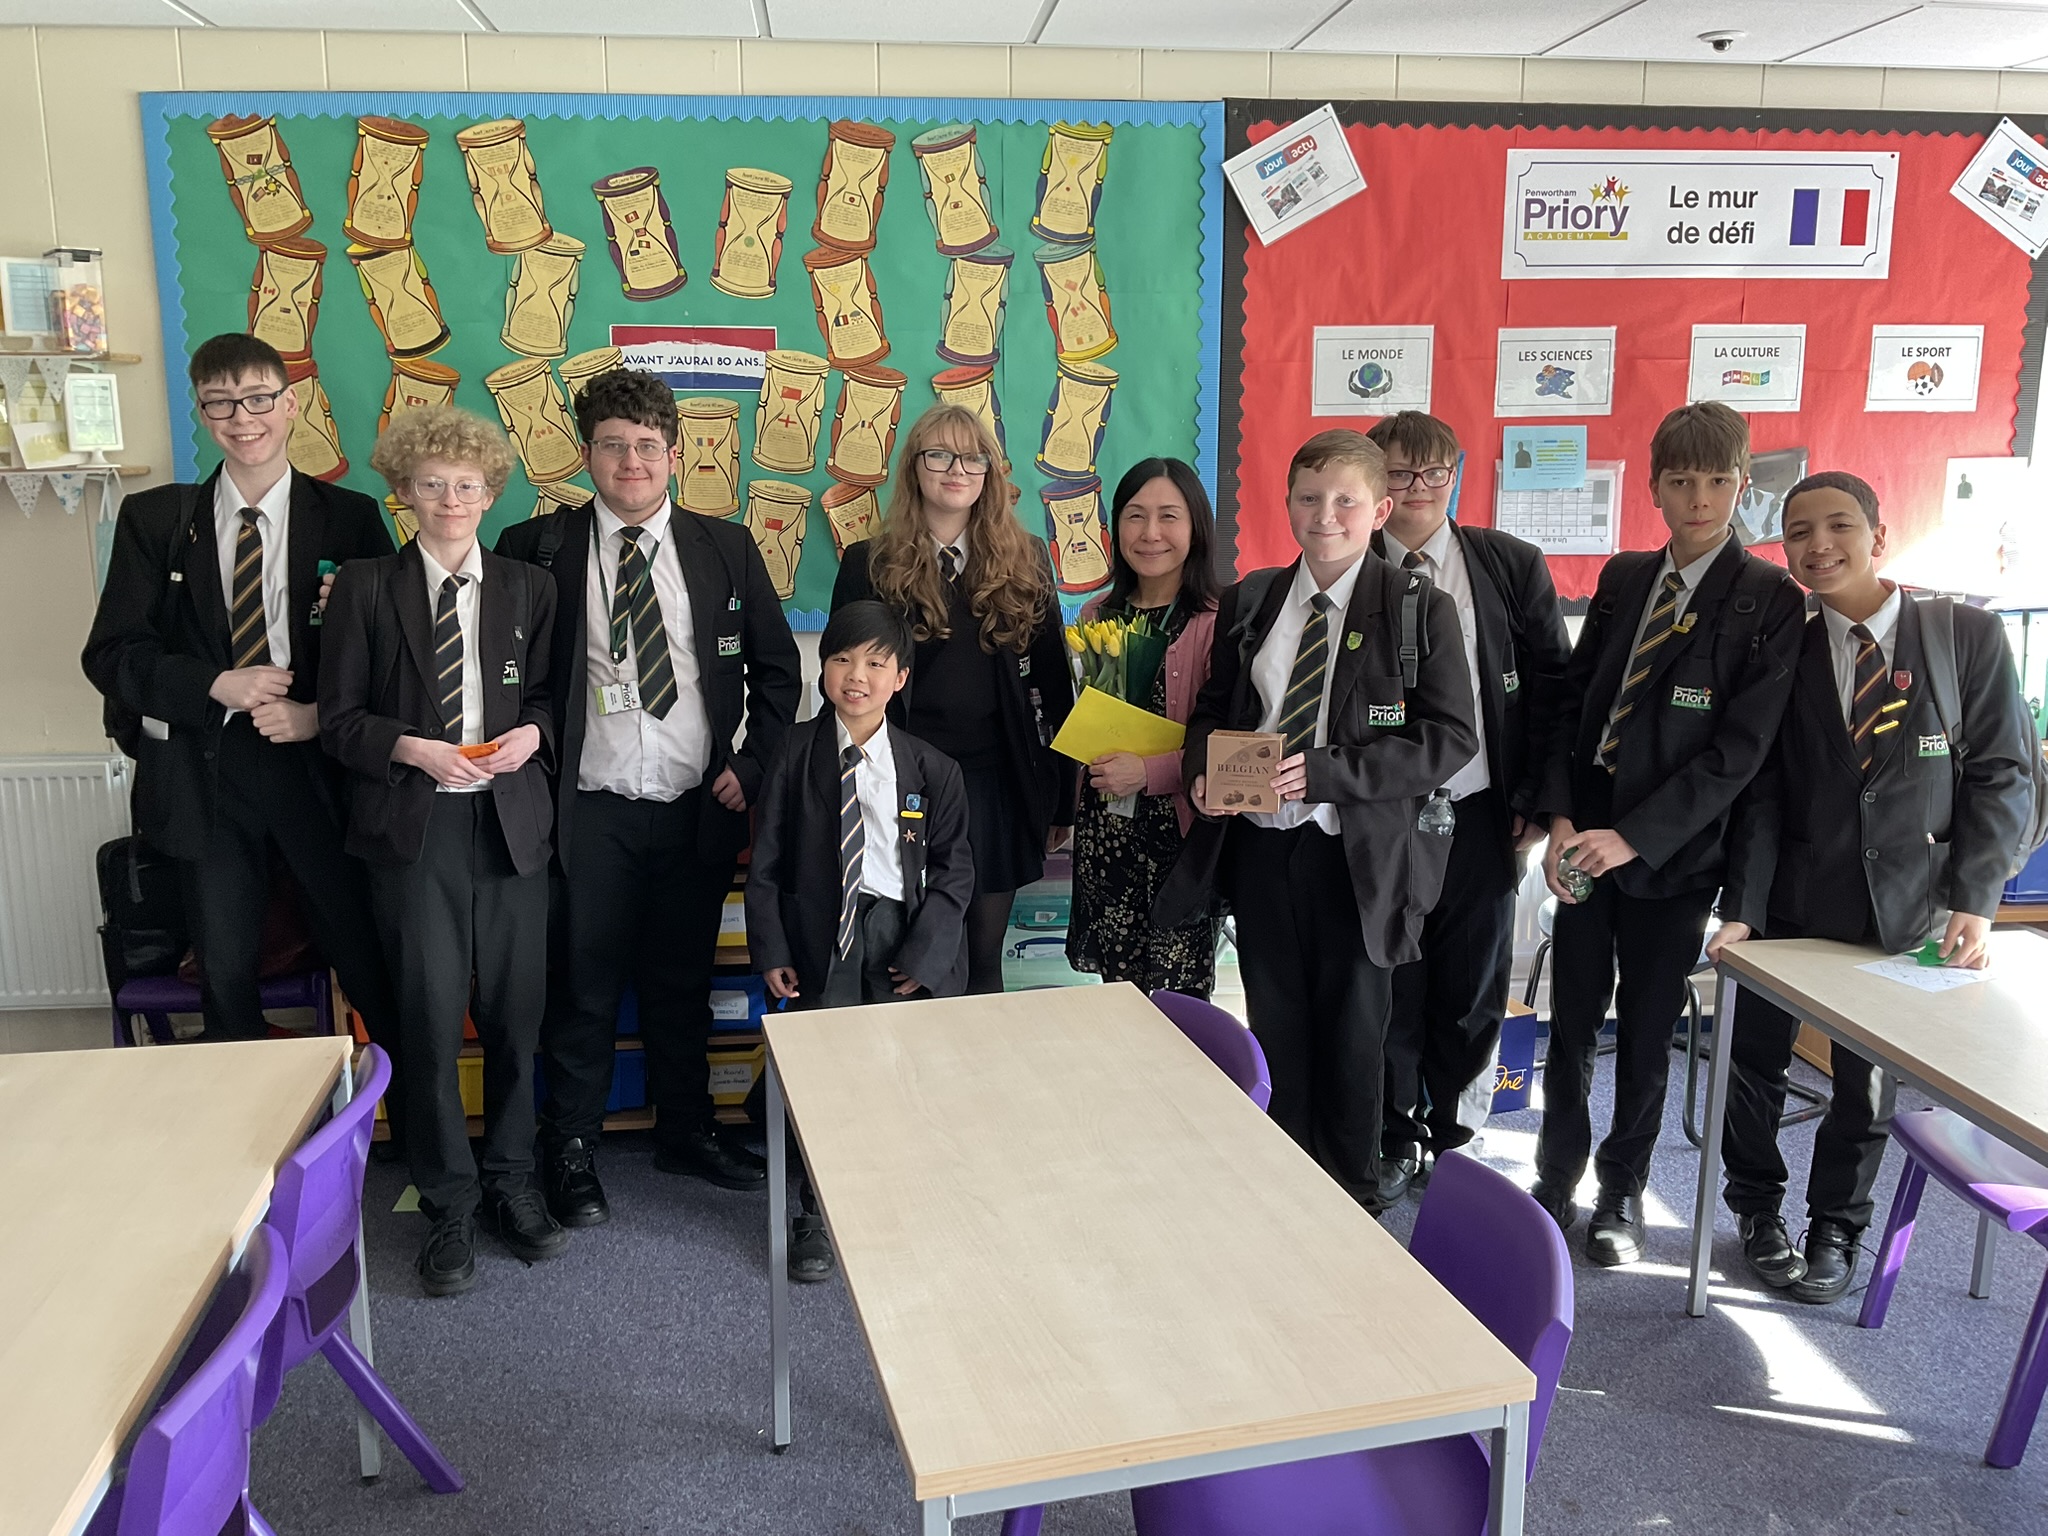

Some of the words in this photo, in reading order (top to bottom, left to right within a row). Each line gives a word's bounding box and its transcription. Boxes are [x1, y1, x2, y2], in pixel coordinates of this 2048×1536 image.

[1525, 189, 1577, 198] Penwortham
[1669, 185, 1699, 209] Le
[1708, 189, 1759, 208] mur
[1523, 198, 1629, 237] Priory
[1667, 221, 1700, 244] de
[1708, 221, 1755, 244] défi
[1342, 349, 1355, 360] LE
[1357, 349, 1404, 360] MONDE
[1518, 351, 1537, 362] LES
[1540, 350, 1593, 362] SCIENCES
[1714, 347, 1728, 358] LA
[1730, 346, 1780, 358] CULTURE
[1901, 347, 1914, 358] LE
[1916, 347, 1952, 358] SPORT
[623, 355, 664, 365] AVANT
[667, 356, 713, 366] J'AURAI
[717, 357, 731, 366] 80
[622, 682, 632, 709] Priory
[1673, 690, 1711, 707] Priory
[1217, 763, 1269, 775] BELGIAN
